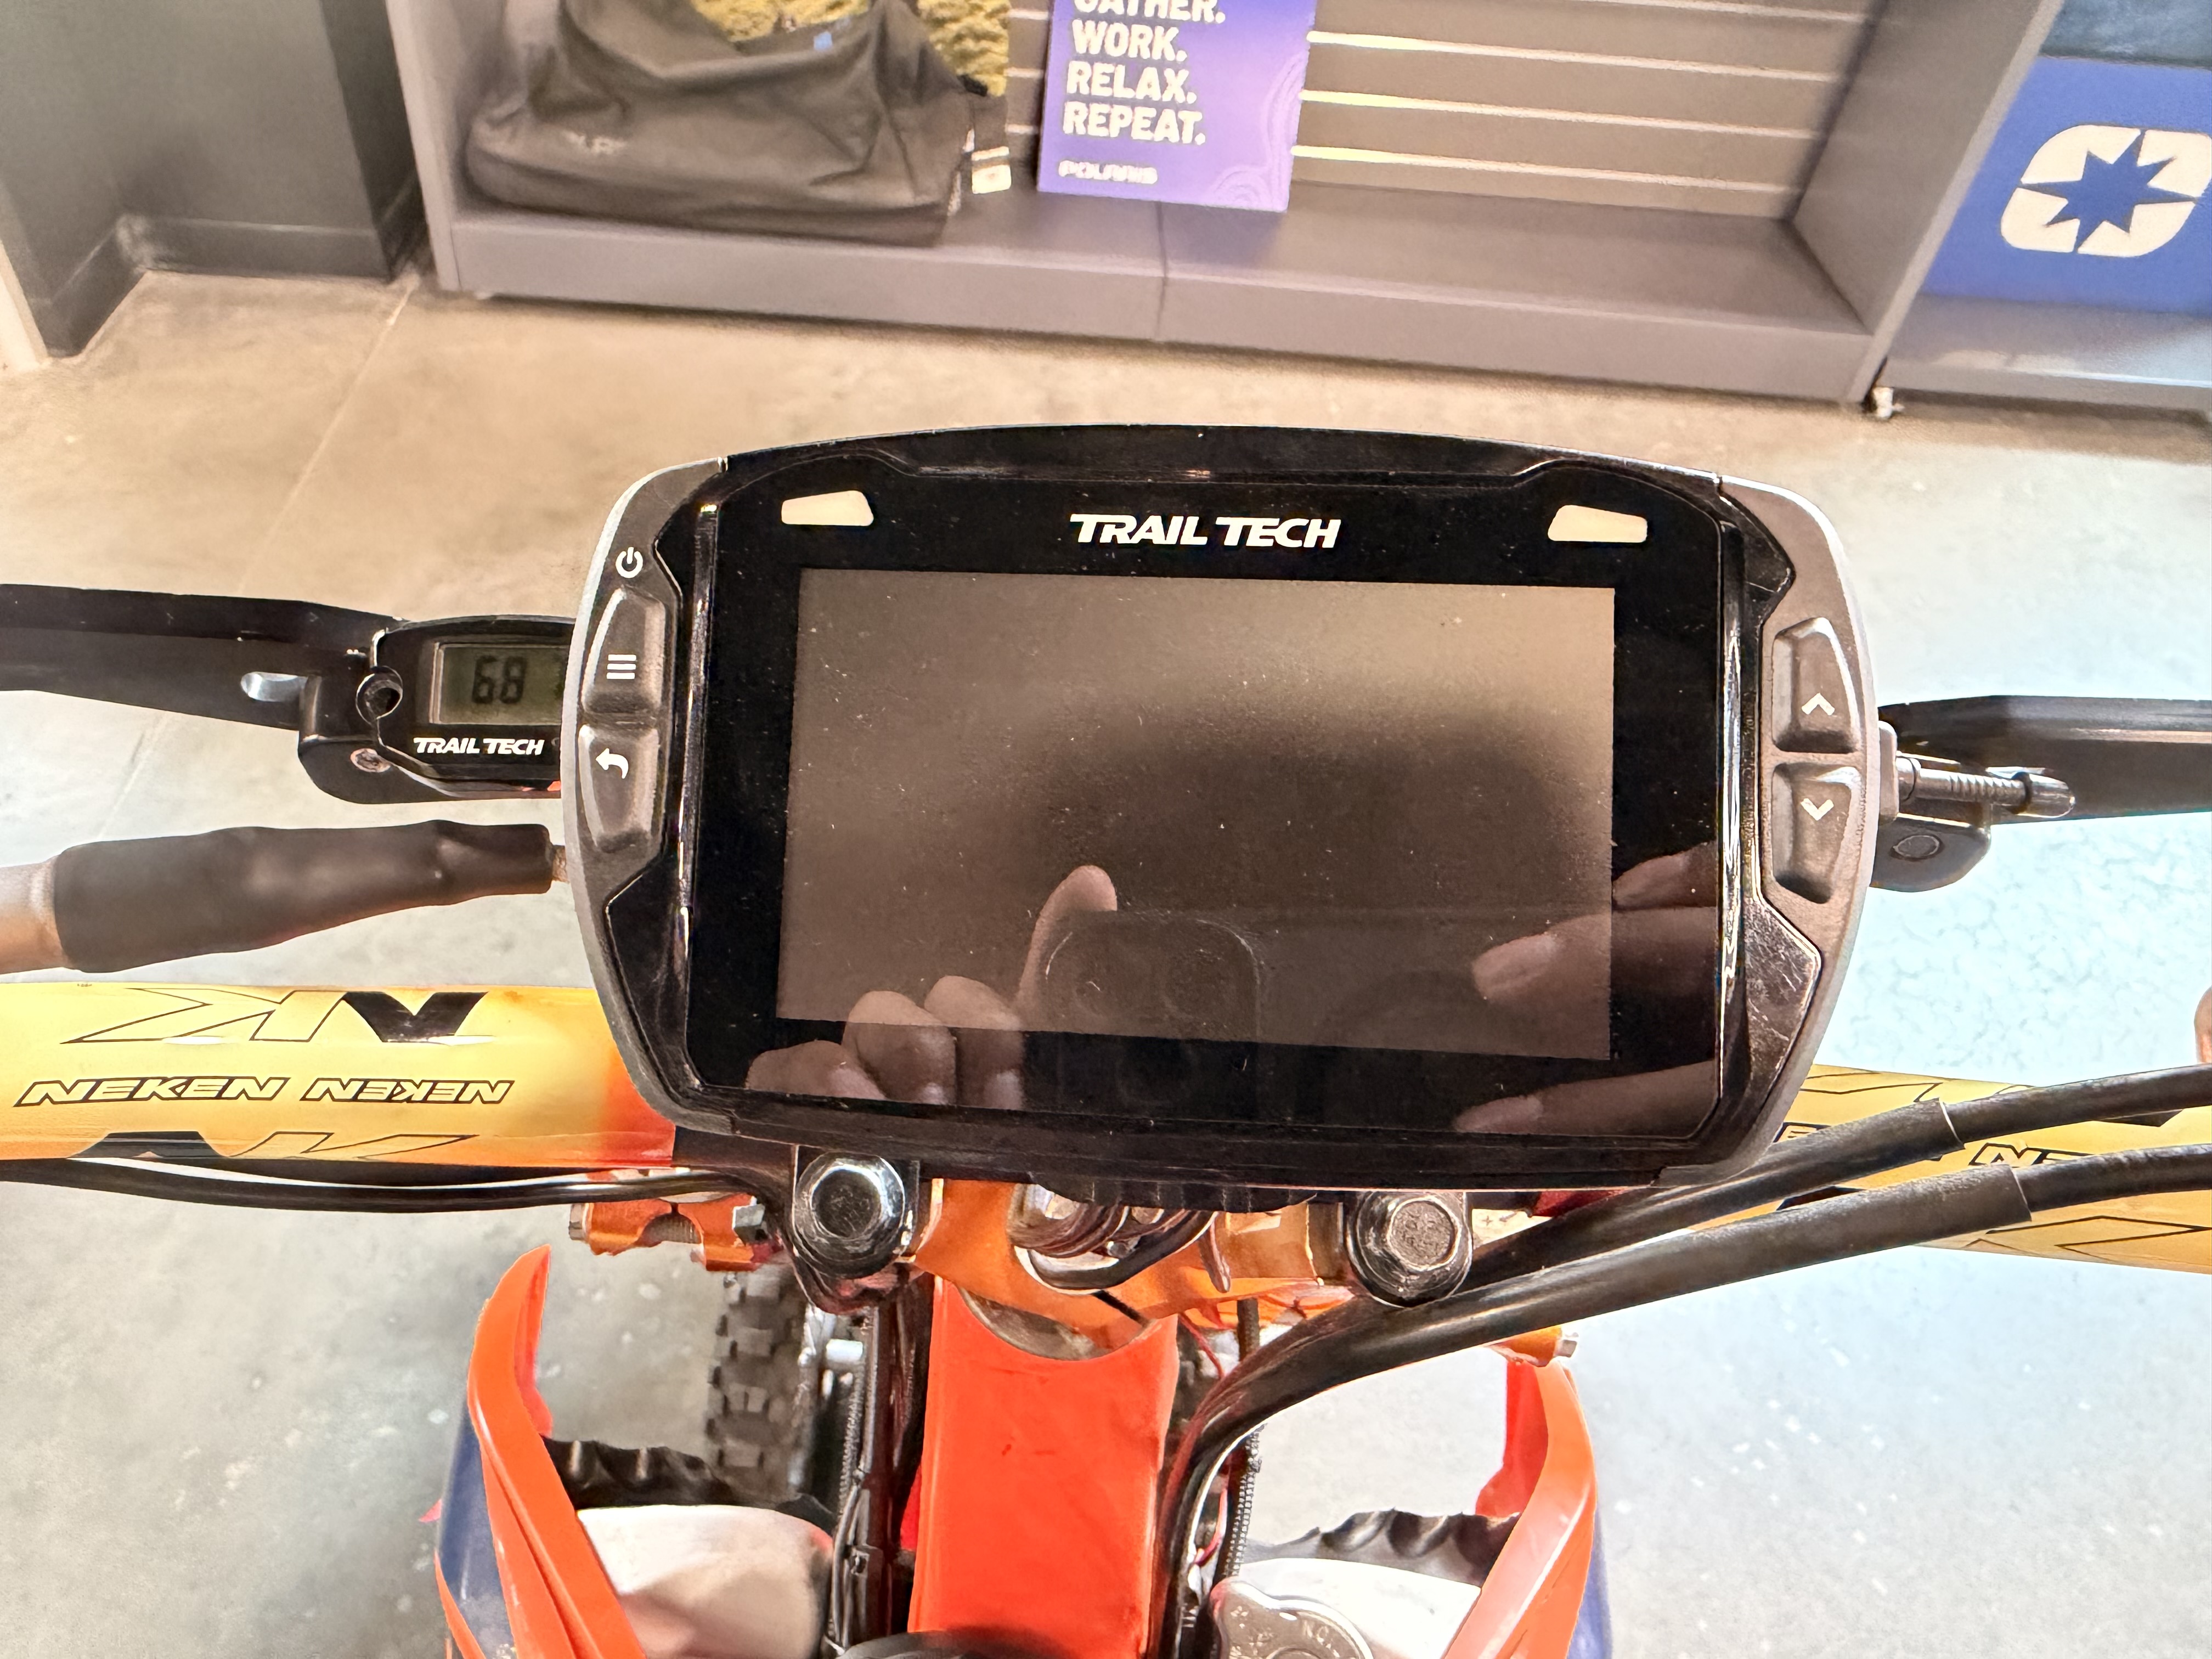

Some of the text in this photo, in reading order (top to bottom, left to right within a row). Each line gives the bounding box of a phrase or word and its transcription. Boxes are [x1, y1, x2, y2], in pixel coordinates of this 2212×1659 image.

[1072, 19, 1188, 62] WORK.
[1066, 60, 1197, 104] RELAX.
[1063, 101, 1206, 145] REPEAT.
[1070, 514, 1341, 548] TRAIL TECH
[472, 656, 527, 704] 68
[413, 737, 545, 755] TRAIL TECH
[13, 1076, 291, 1107] NEKEN
